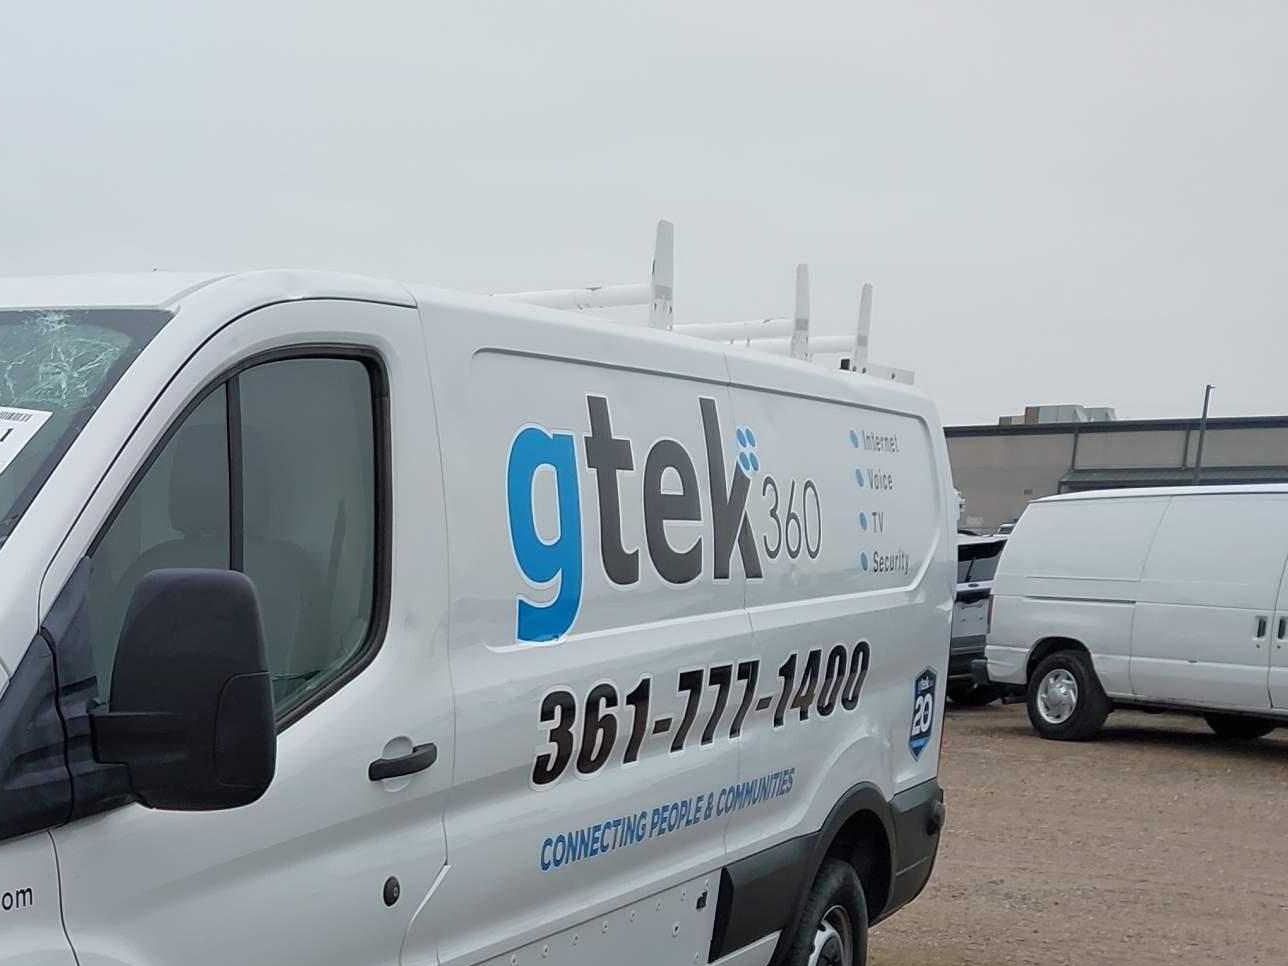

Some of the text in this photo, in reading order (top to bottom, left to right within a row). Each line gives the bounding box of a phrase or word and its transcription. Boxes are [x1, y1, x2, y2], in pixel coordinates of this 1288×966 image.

[862, 429, 900, 453] Internet
[867, 468, 894, 491] Voice
[507, 395, 822, 643] gtek360
[871, 511, 885, 534] TV
[872, 550, 910, 575] Security
[531, 640, 871, 786] 361-777-1400
[540, 767, 796, 871] CONNECTING PEOPLE & COMMUNITIES
